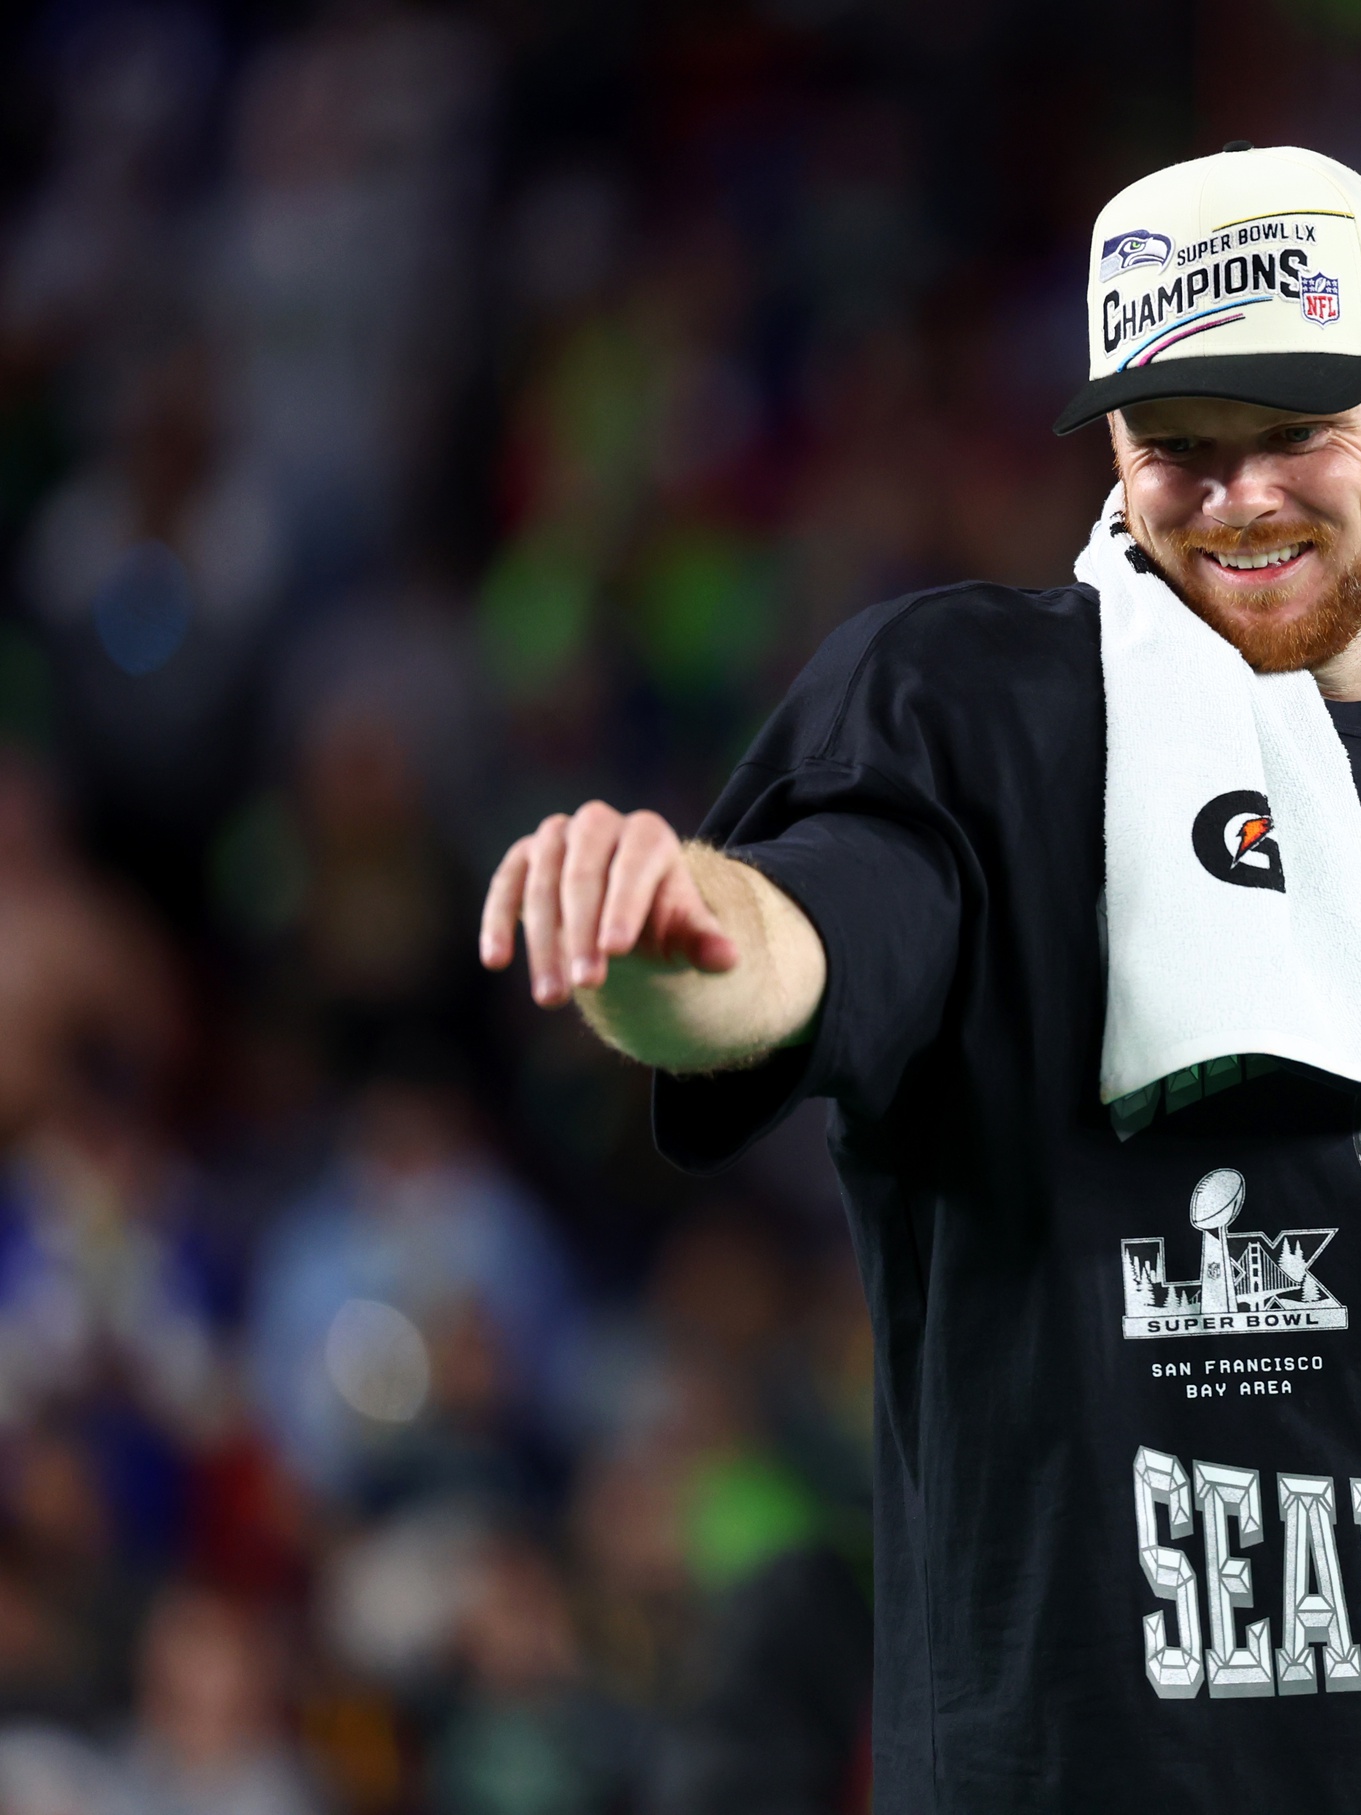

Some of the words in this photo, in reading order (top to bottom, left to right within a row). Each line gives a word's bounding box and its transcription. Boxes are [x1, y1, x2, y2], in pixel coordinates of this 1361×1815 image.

[1177, 233, 1231, 267] SUPER
[1238, 222, 1290, 246] BOWL
[1295, 223, 1317, 243] LX
[1102, 248, 1308, 354] CHAMPIONS
[1305, 295, 1337, 320] NFL
[1147, 1316, 1235, 1334] SUPER
[1246, 1312, 1320, 1329] BOWL
[1151, 1361, 1192, 1378] SAN
[1204, 1355, 1324, 1375] FRANCISCO
[1185, 1382, 1227, 1399] BAY
[1239, 1379, 1293, 1396] AREA
